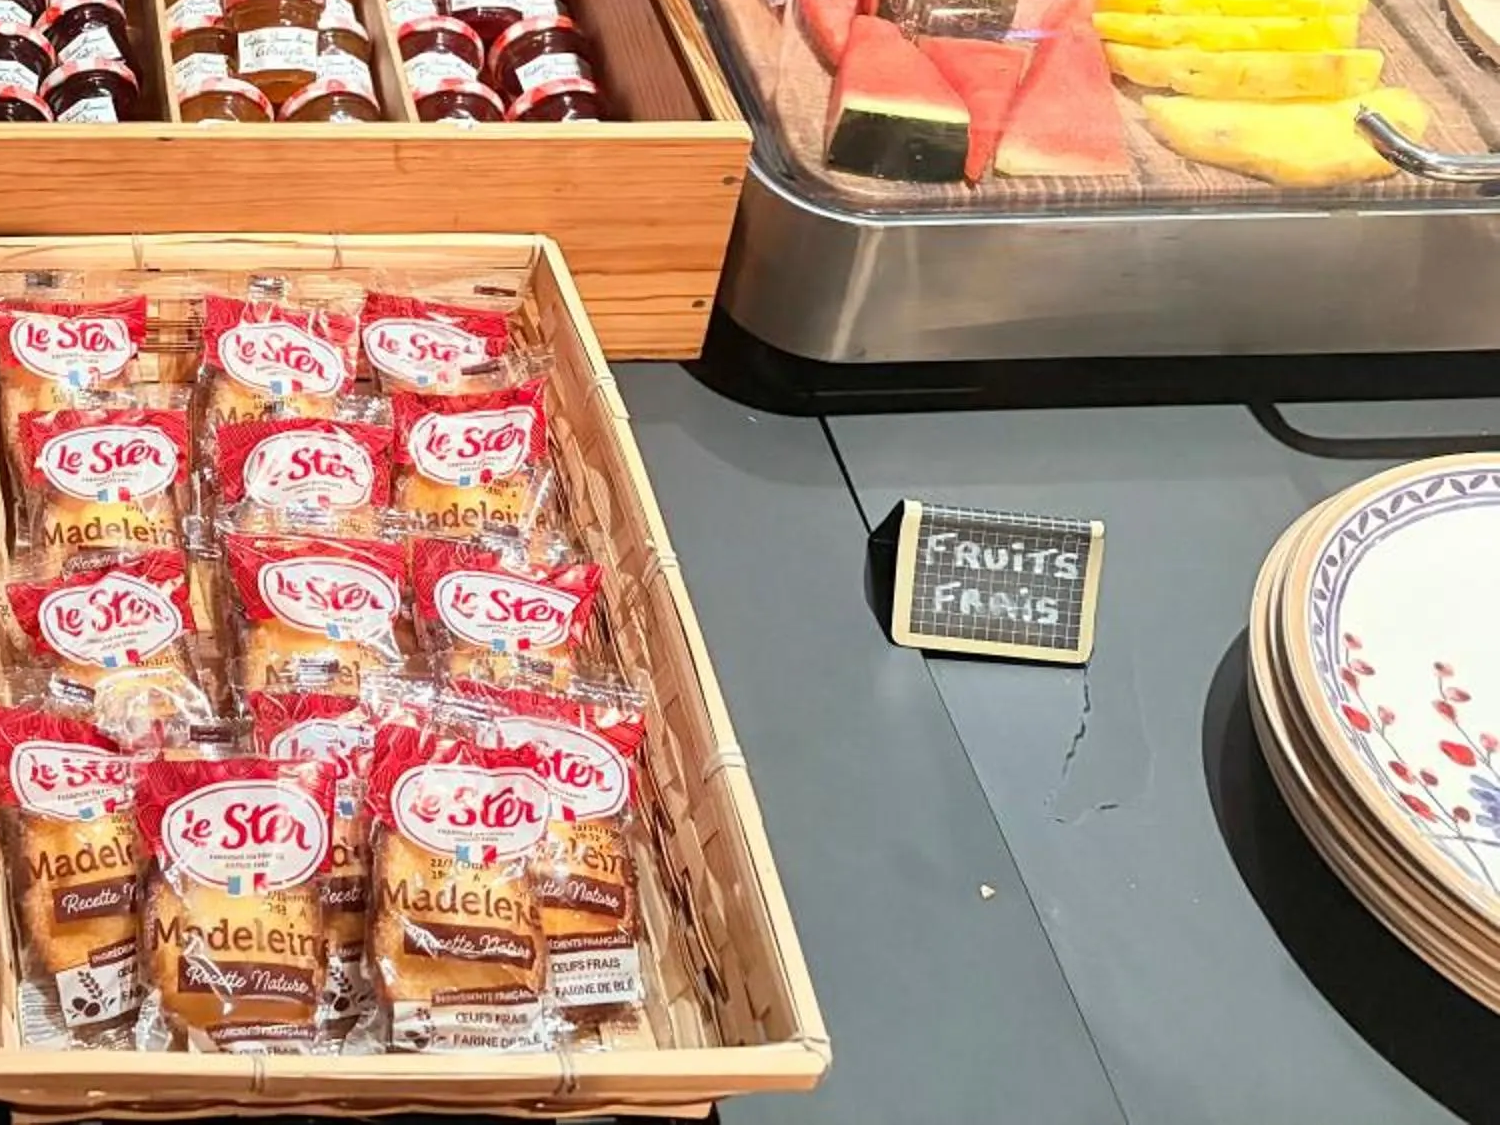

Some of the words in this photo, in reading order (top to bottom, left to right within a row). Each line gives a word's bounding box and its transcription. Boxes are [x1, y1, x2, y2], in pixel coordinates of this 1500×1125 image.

[25, 322, 50, 352] Le
[261, 332, 330, 381] Ster
[56, 445, 83, 476] Le
[88, 437, 168, 475] Ster
[425, 422, 451, 461] Le
[457, 422, 526, 459] Ster
[274, 570, 302, 602] Le
[304, 577, 386, 611] Ster
[450, 584, 480, 619] Le
[485, 588, 567, 627] Ster
[55, 604, 84, 637] Le
[85, 585, 172, 630] Ster
[29, 756, 58, 792] Le
[446, 786, 543, 829] Ster
[180, 809, 213, 848] Le
[220, 802, 313, 853] Ster
[61, 885, 122, 916] Recette
[567, 880, 620, 909] Nature
[250, 969, 310, 995] Nature
[587, 957, 622, 972] FRAIS
[597, 982, 612, 994] DE
